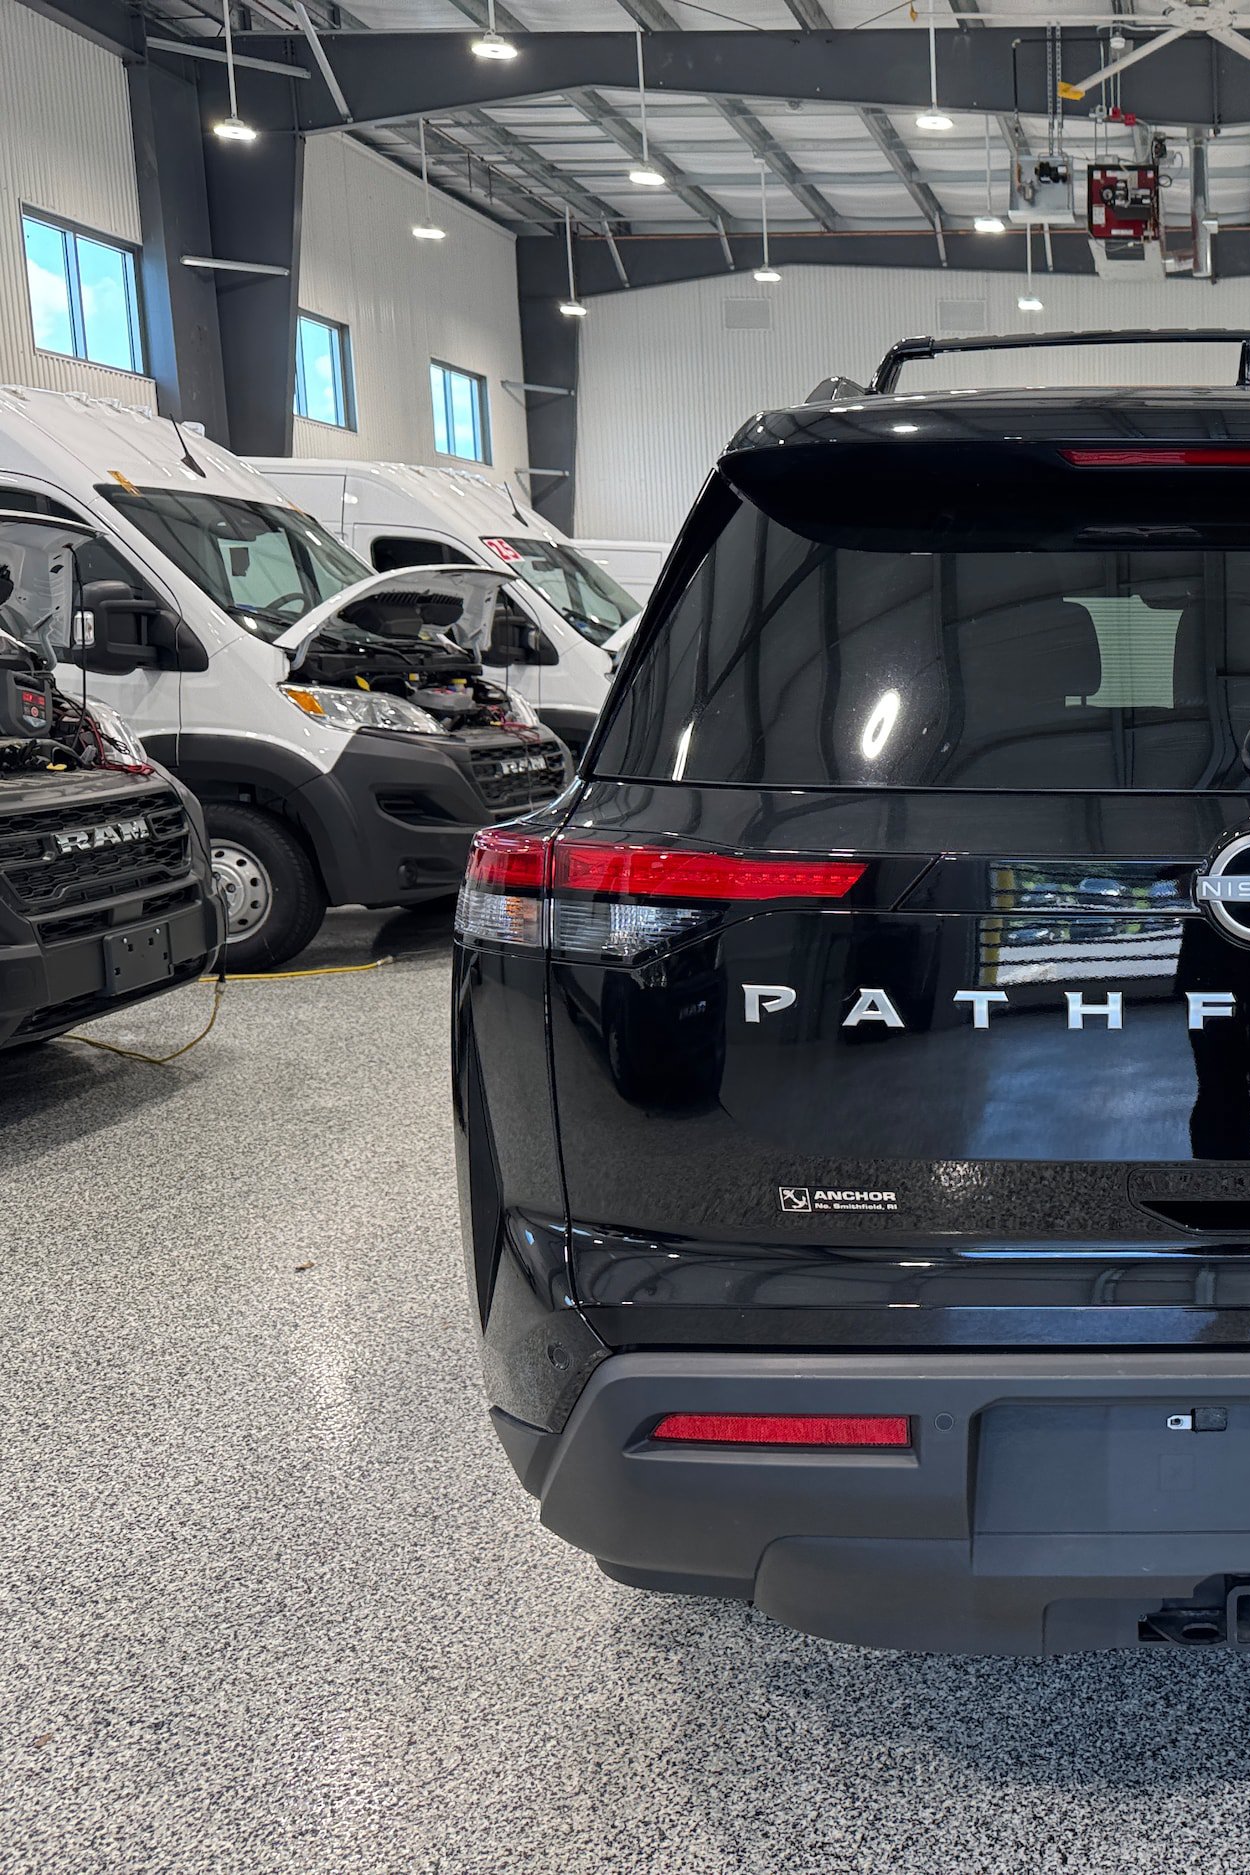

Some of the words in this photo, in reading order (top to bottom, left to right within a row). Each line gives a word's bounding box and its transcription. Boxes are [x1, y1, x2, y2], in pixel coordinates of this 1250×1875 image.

[501, 754, 547, 775] RAM
[53, 818, 150, 854] RAM
[813, 1189, 897, 1202] ANCHOR
[814, 1202, 832, 1210] No.
[832, 1202, 885, 1211] Smithfield,
[886, 1203, 898, 1211] RI
